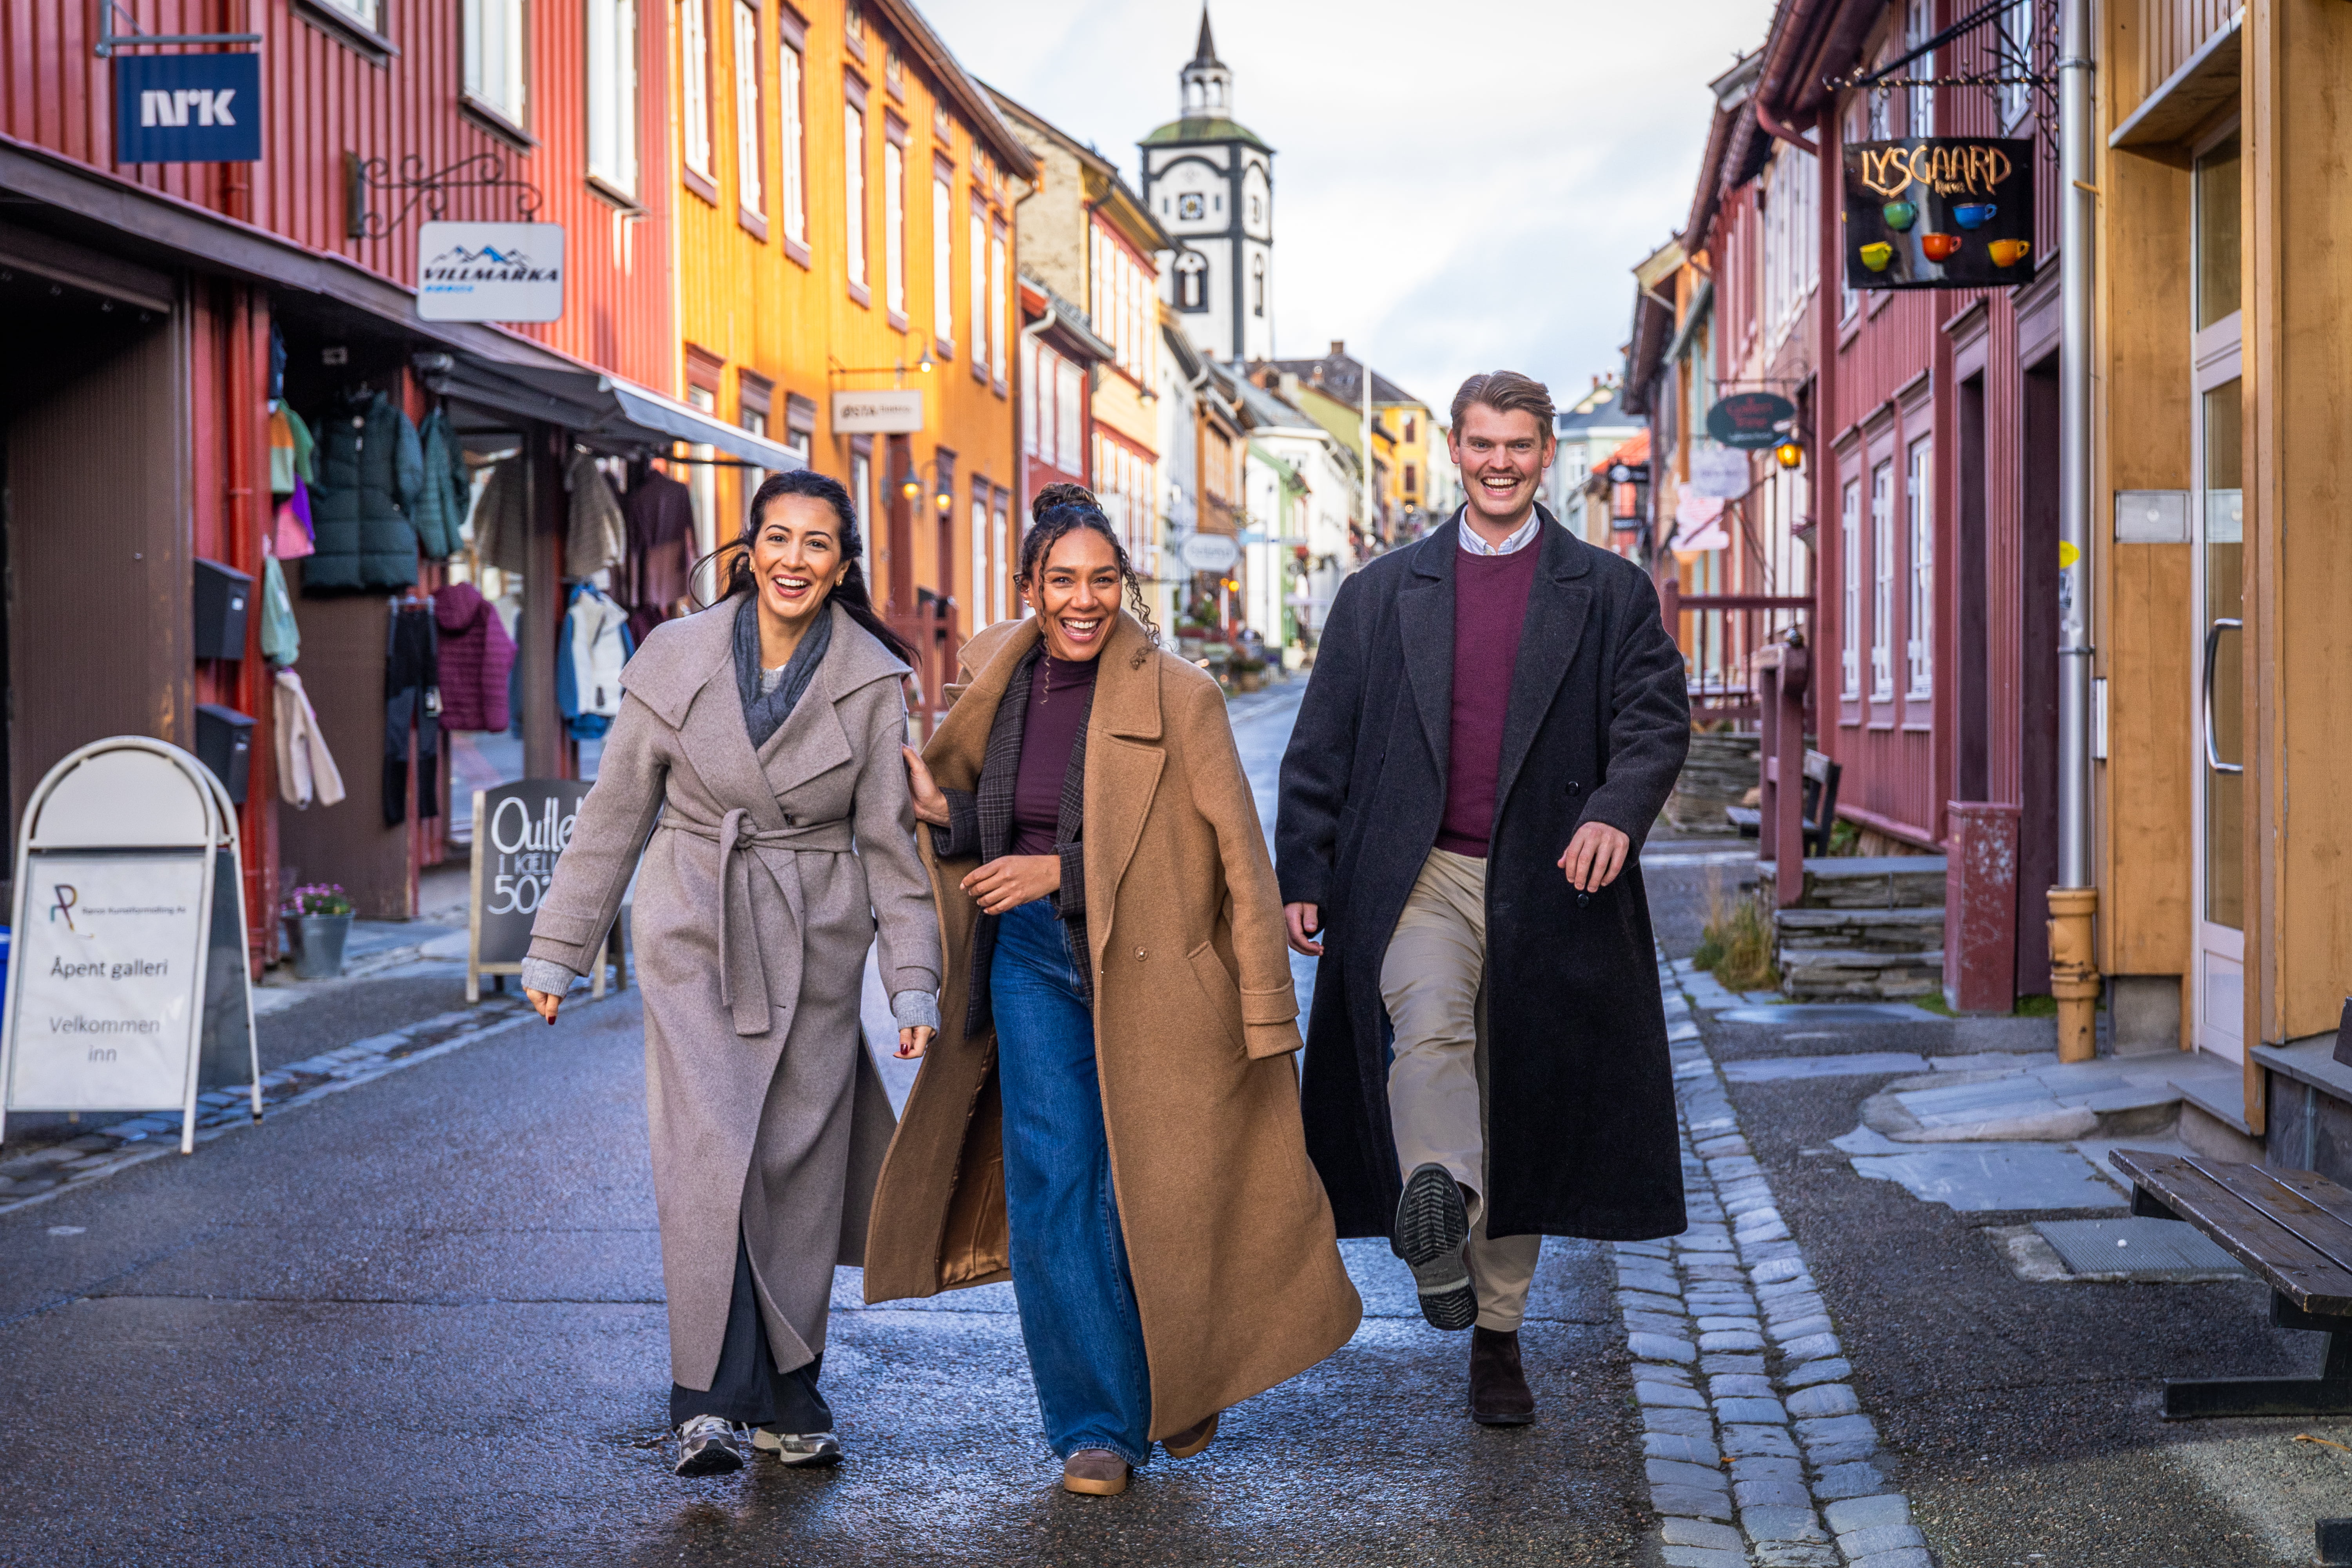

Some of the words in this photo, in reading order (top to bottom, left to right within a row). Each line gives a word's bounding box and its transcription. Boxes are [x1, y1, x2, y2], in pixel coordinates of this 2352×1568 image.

[141, 89, 237, 127] NRK
[1862, 145, 2011, 198] LYSGAARD
[425, 268, 558, 281] VILLMARKA
[51, 955, 105, 980] Åpent
[111, 958, 168, 981] galleri
[49, 1014, 160, 1034] Velkommen
[88, 1044, 118, 1062] inn
